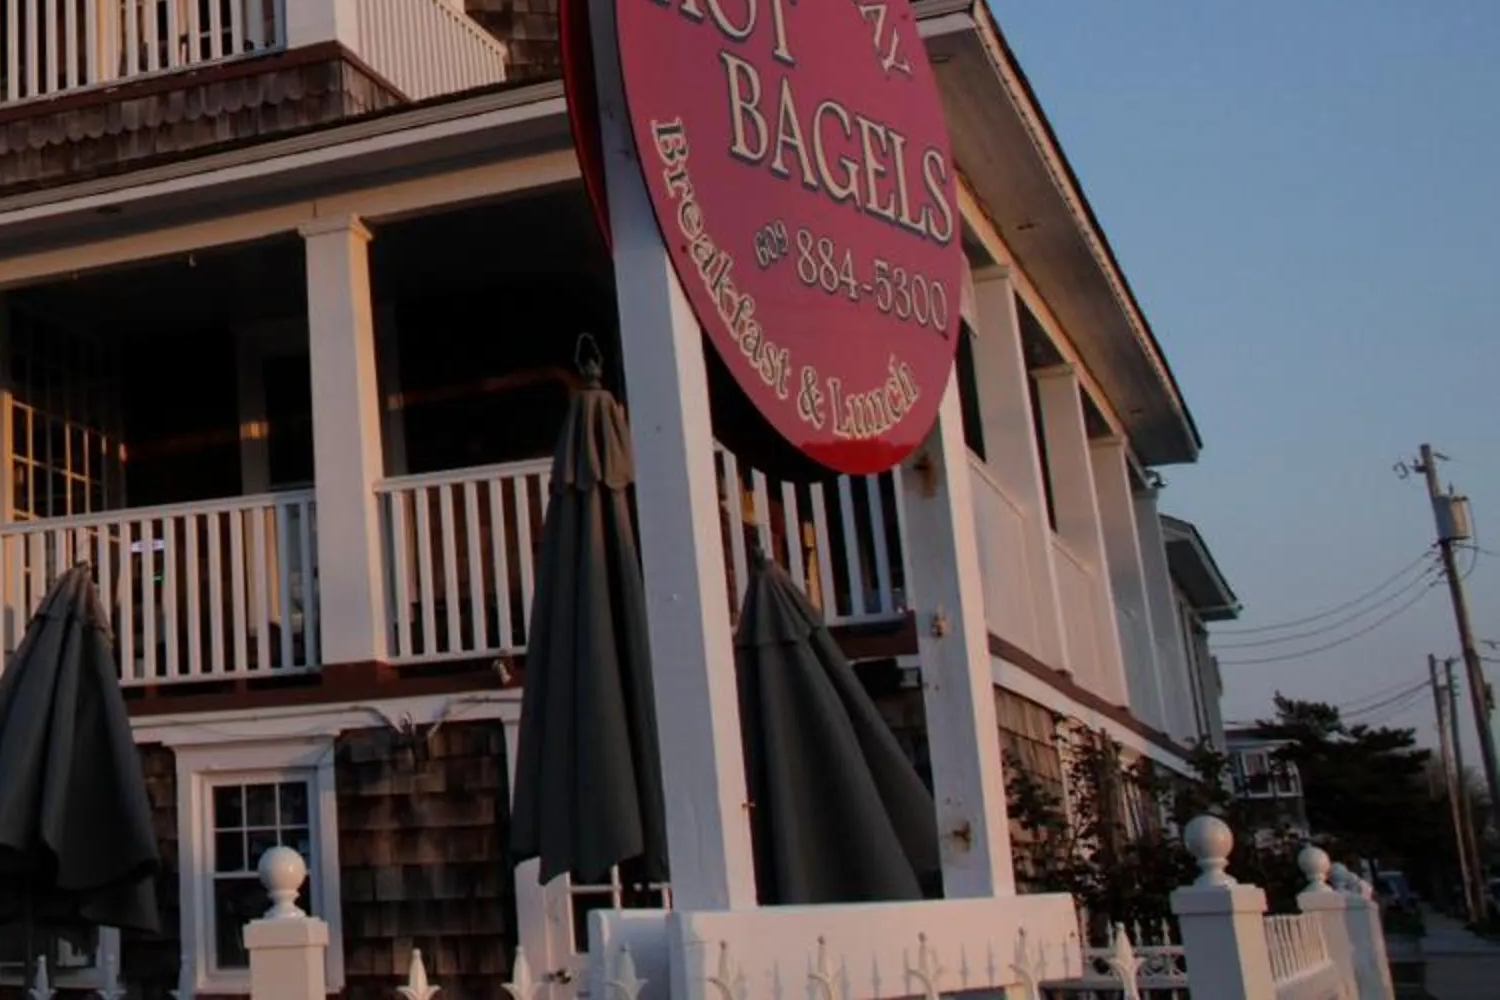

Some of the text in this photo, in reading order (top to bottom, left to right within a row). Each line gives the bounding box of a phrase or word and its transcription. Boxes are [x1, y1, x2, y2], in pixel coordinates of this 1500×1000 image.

[719, 51, 954, 245] BAGELS
[650, 116, 920, 437] Breakfast & Lunch
[796, 229, 949, 333] 884-5300
